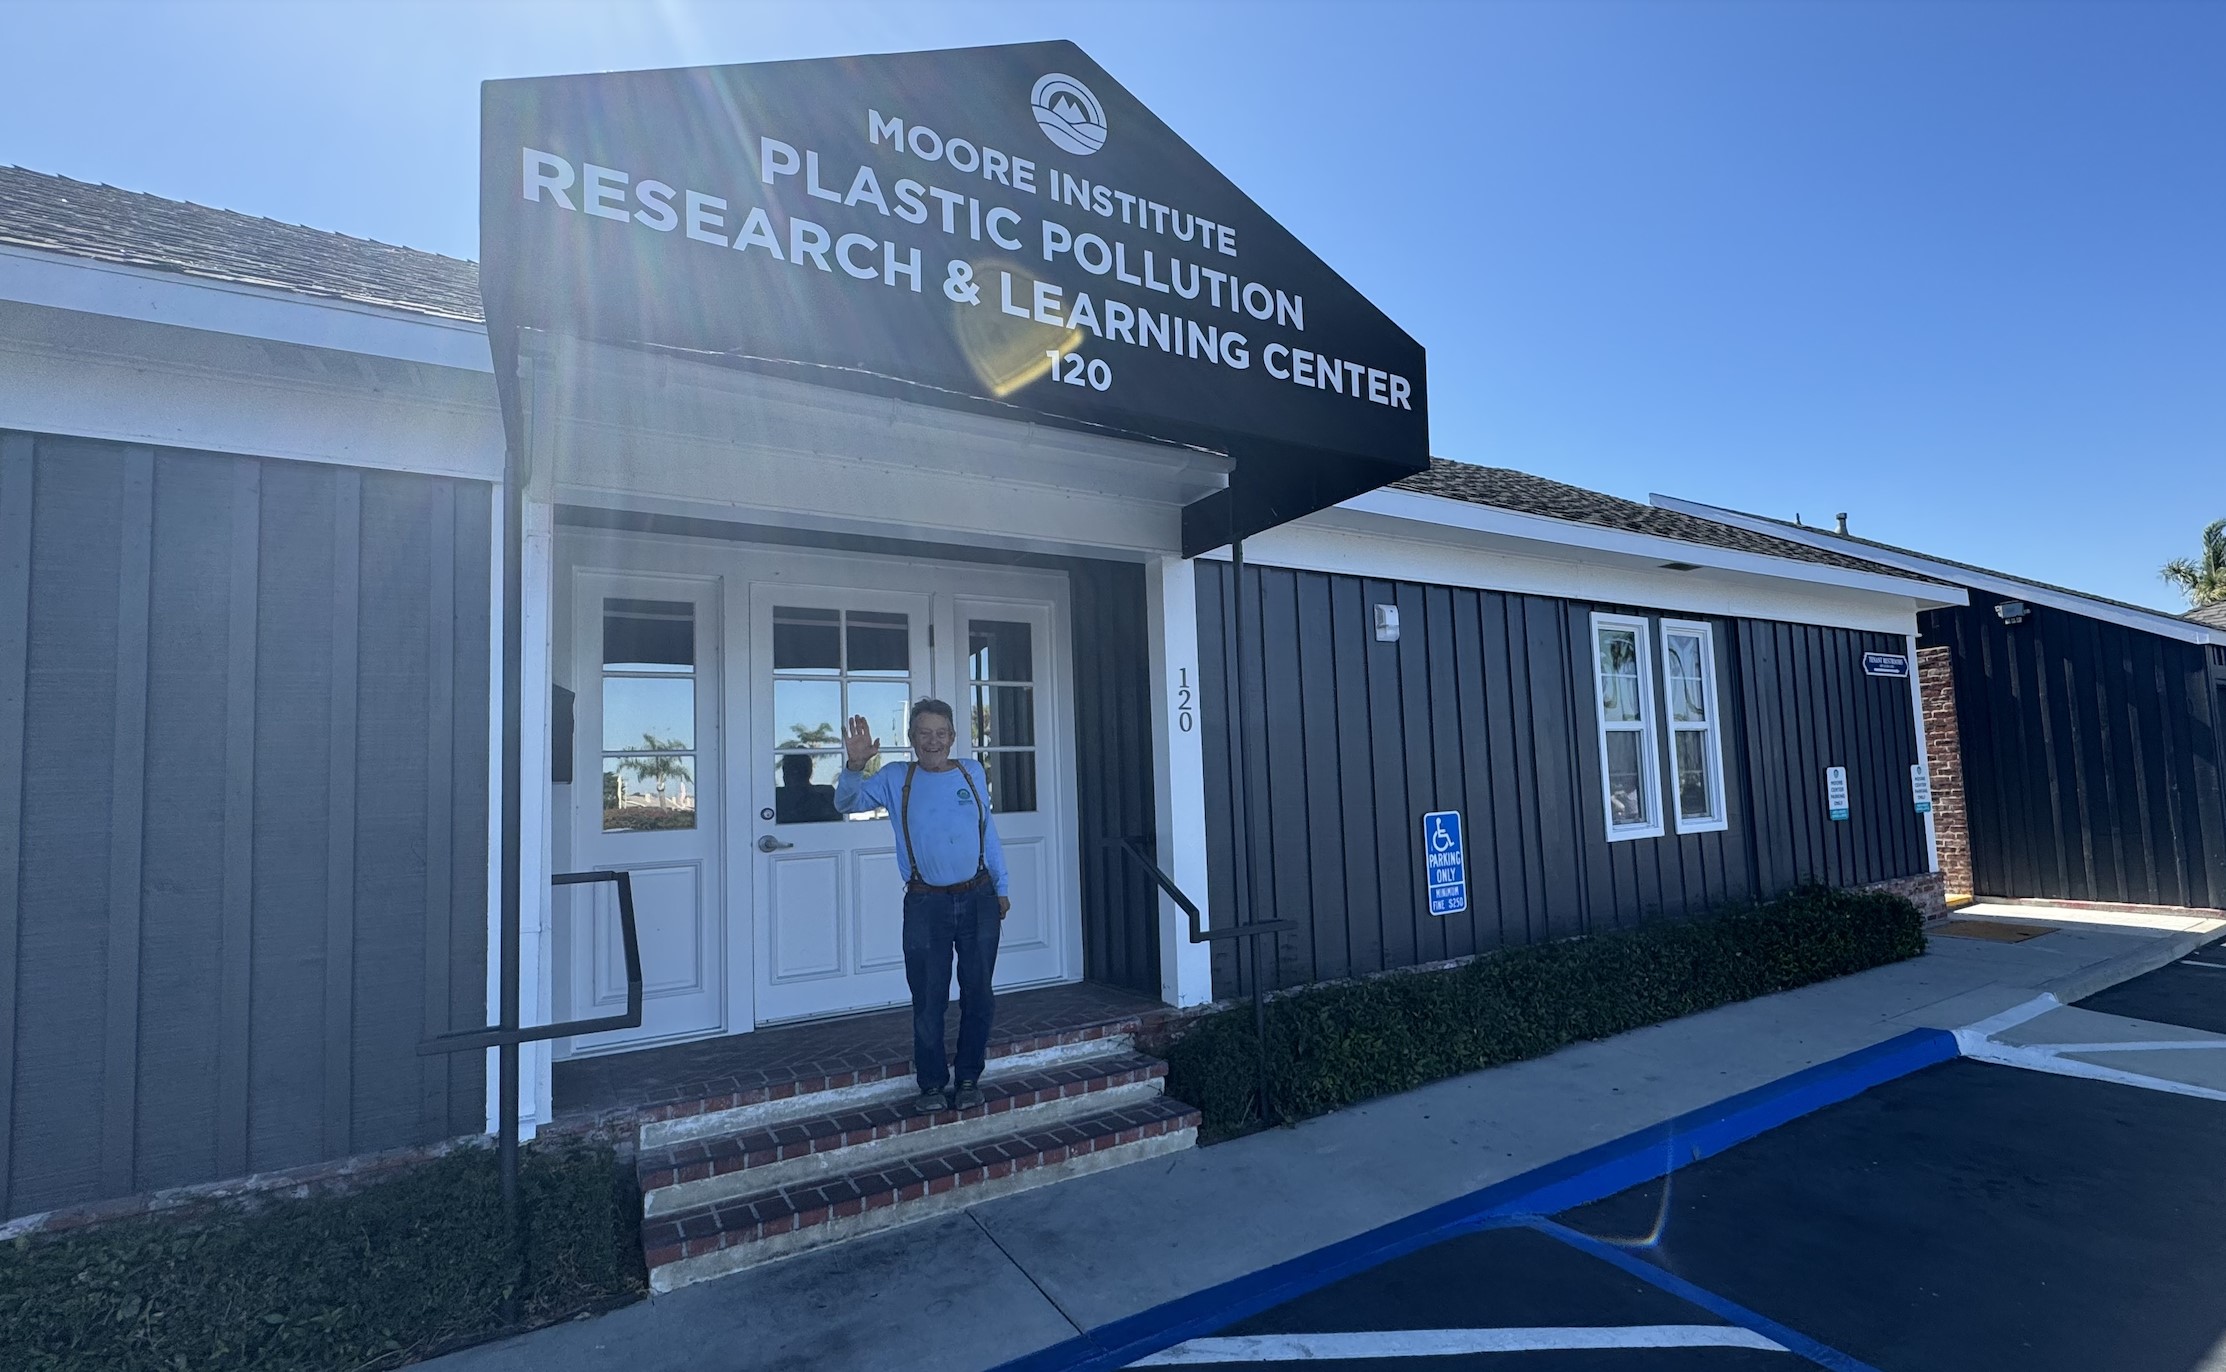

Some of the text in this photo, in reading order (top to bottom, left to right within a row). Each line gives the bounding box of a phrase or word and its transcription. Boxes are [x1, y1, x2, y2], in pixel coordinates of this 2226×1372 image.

[868, 109, 1237, 257] MOORE INSTITUTE
[761, 136, 1304, 331] PLASTIC POLLUTION
[522, 147, 1412, 411] RESEARCH & LEARNING CENTER
[1046, 350, 1112, 392] 120
[1178, 667, 1193, 732] 120
[1429, 851, 1461, 868] PARKING
[1436, 867, 1456, 883] ONLY
[1433, 897, 1463, 910] FINE $250
[1436, 886, 1459, 898] MINIMUM
